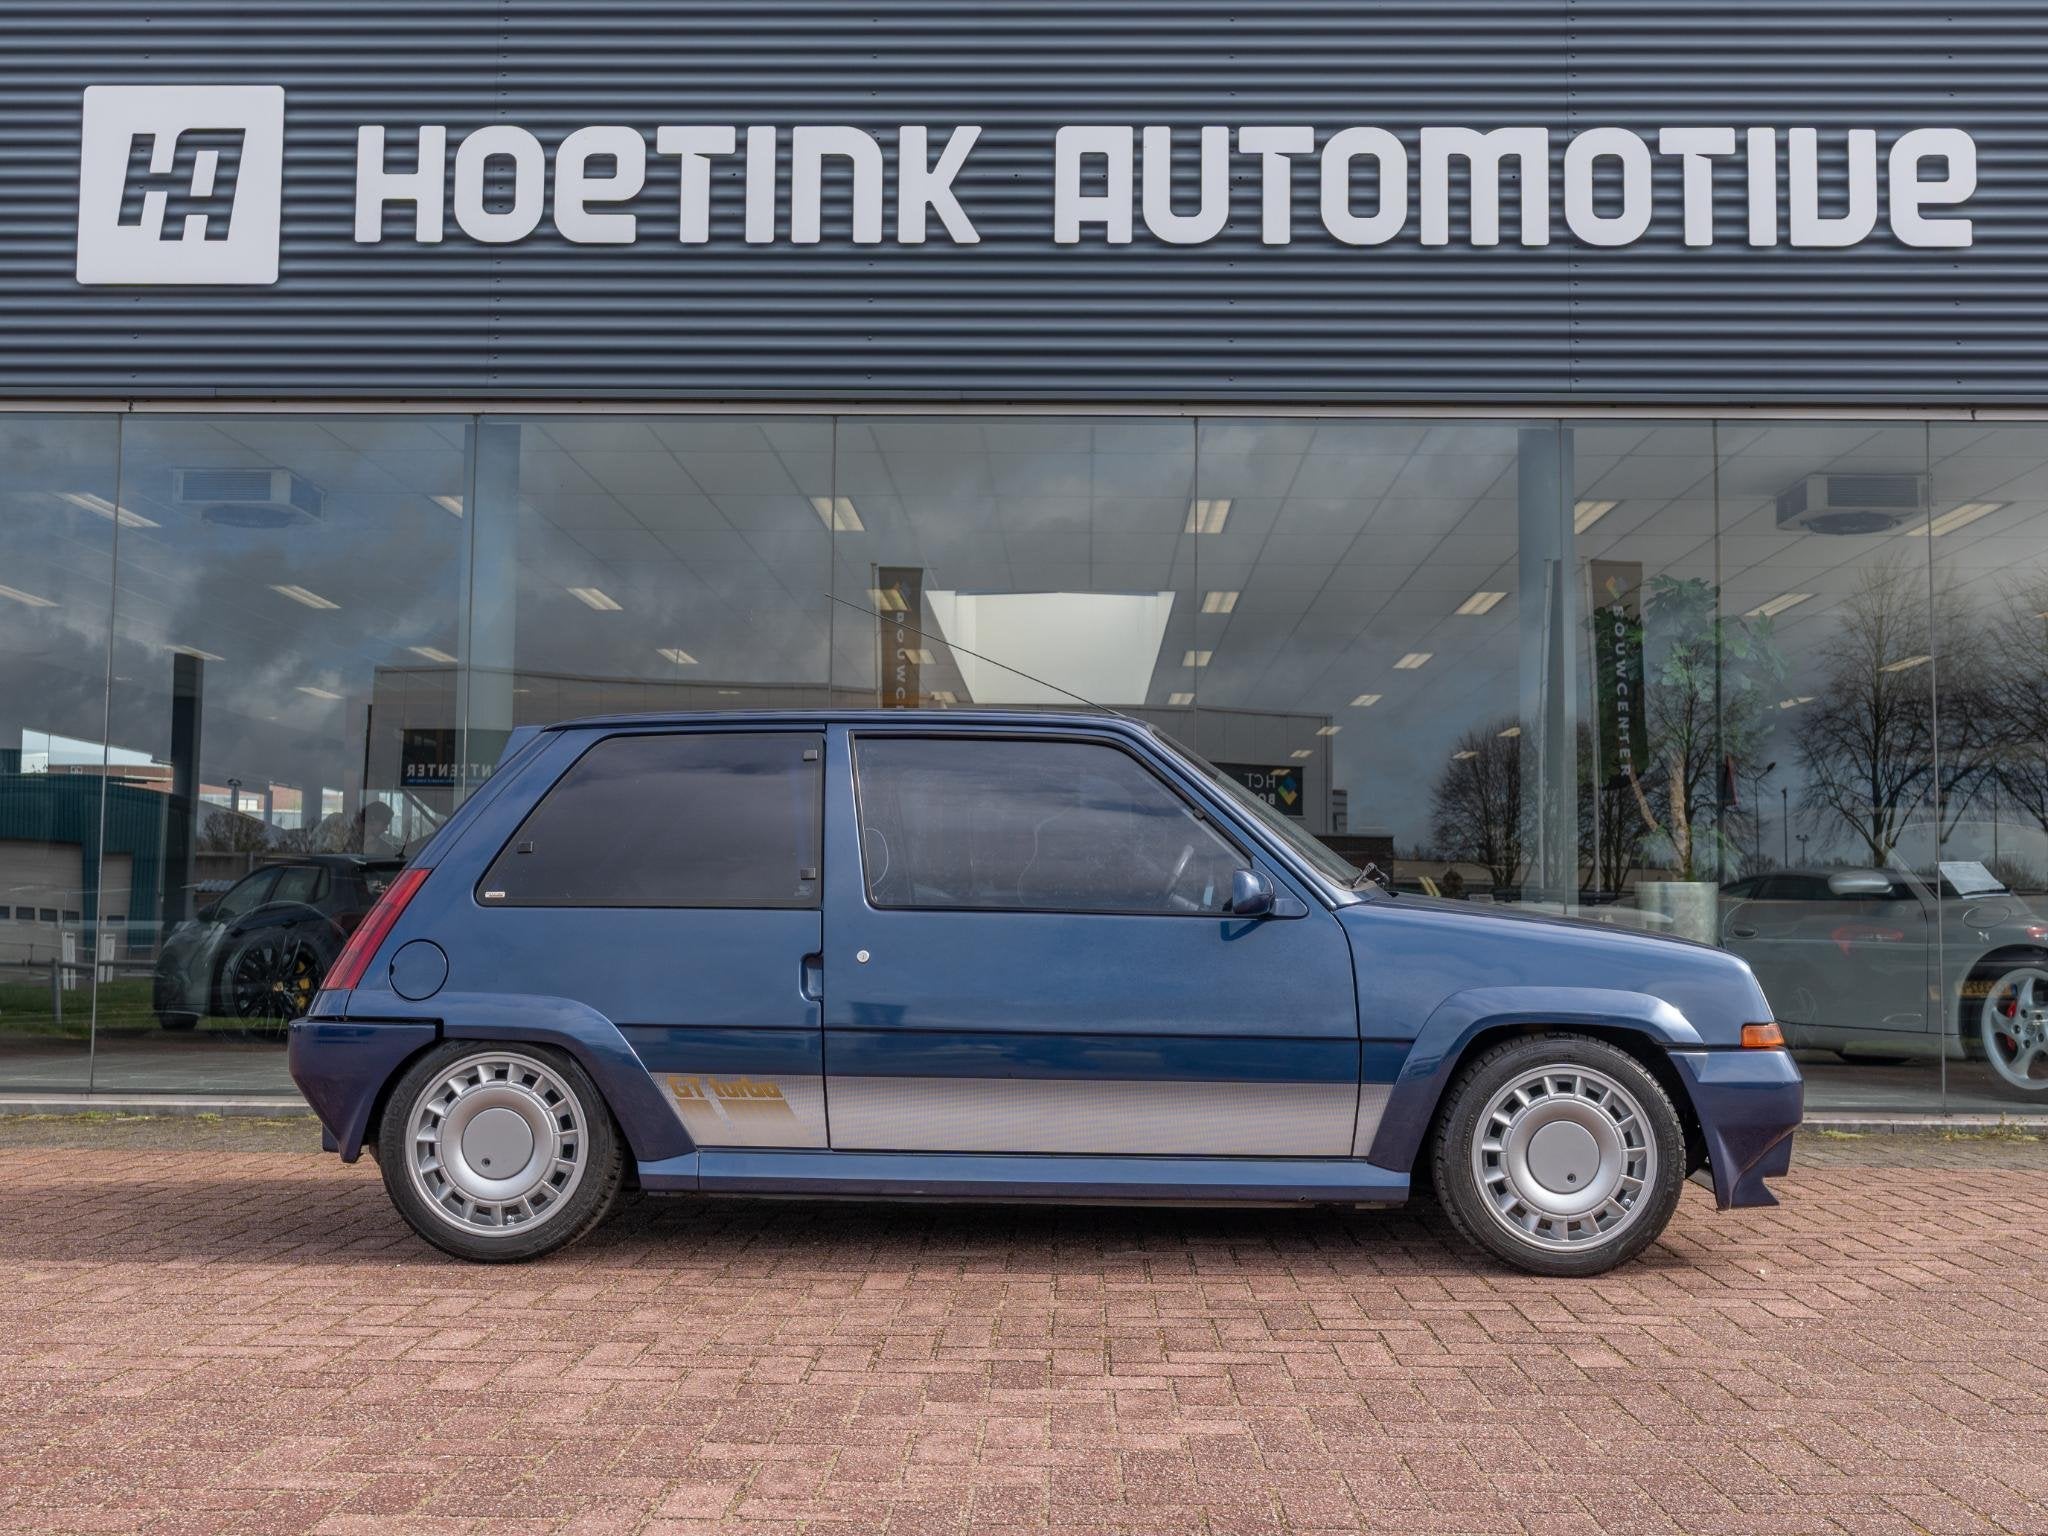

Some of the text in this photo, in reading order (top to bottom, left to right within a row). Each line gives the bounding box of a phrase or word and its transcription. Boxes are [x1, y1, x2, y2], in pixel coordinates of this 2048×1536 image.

[354, 125, 1977, 247] HOETINK AUTOMOTIVE
[896, 611, 906, 709] BOUWC
[1612, 605, 1632, 777] BOUWCENTER
[667, 1076, 784, 1098] GT turbo
